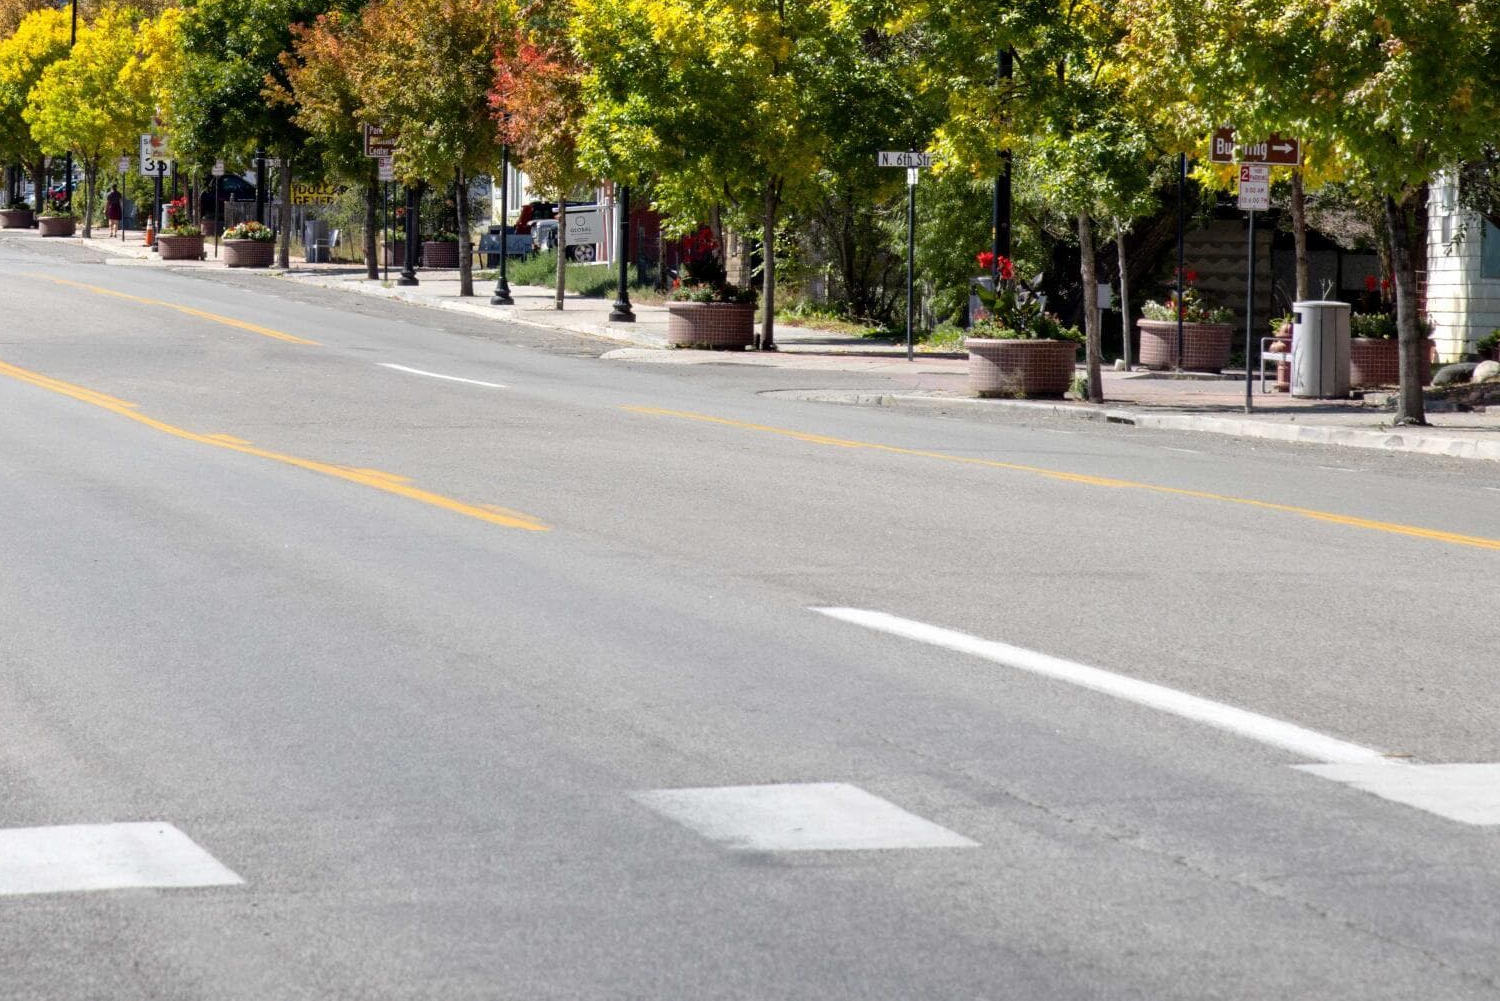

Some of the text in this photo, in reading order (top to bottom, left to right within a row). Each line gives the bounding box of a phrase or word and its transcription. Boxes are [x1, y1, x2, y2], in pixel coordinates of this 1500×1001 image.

[1216, 138, 1268, 160] Buing
[882, 152, 932, 166] N. 6th Str
[1241, 168, 1249, 180] 2
